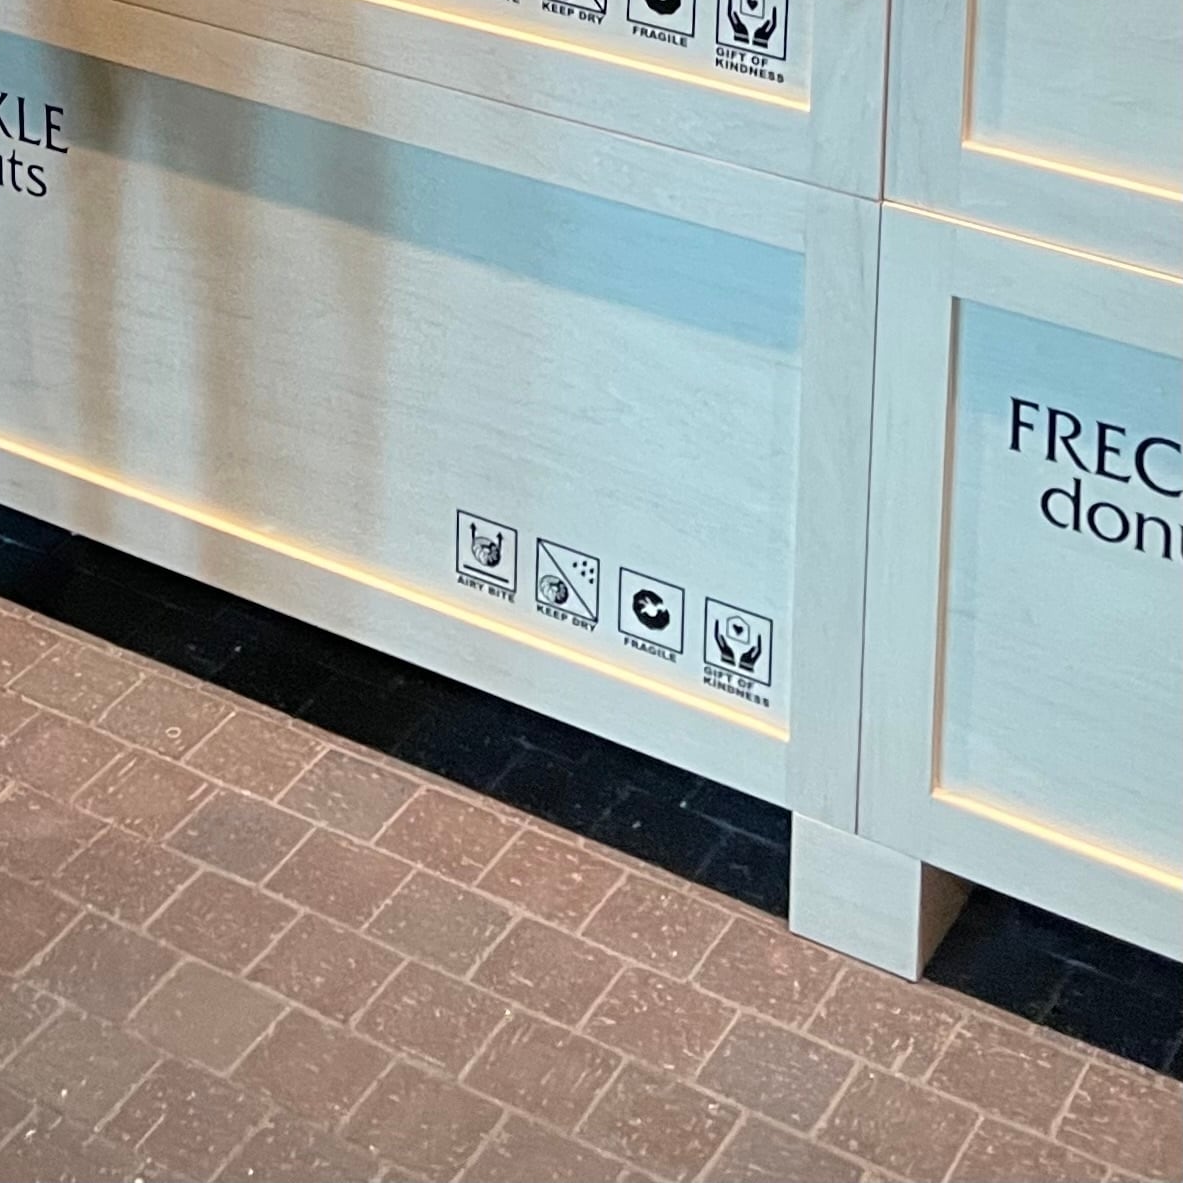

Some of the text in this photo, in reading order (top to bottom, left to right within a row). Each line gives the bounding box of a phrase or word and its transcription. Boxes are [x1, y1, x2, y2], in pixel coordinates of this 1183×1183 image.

[542, 1, 604, 25] KEEP DRY
[632, 25, 688, 48] FRAGILE
[716, 47, 768, 67] GIFT OF
[715, 57, 784, 84] KINDNESS
[1040, 477, 1183, 561] don
[457, 575, 515, 604] AIRY BITE
[536, 604, 596, 632] KEEP DRY
[624, 637, 677, 663] FRAGILE
[704, 666, 755, 690] GIFT OF
[703, 676, 769, 708] KINDNESS
